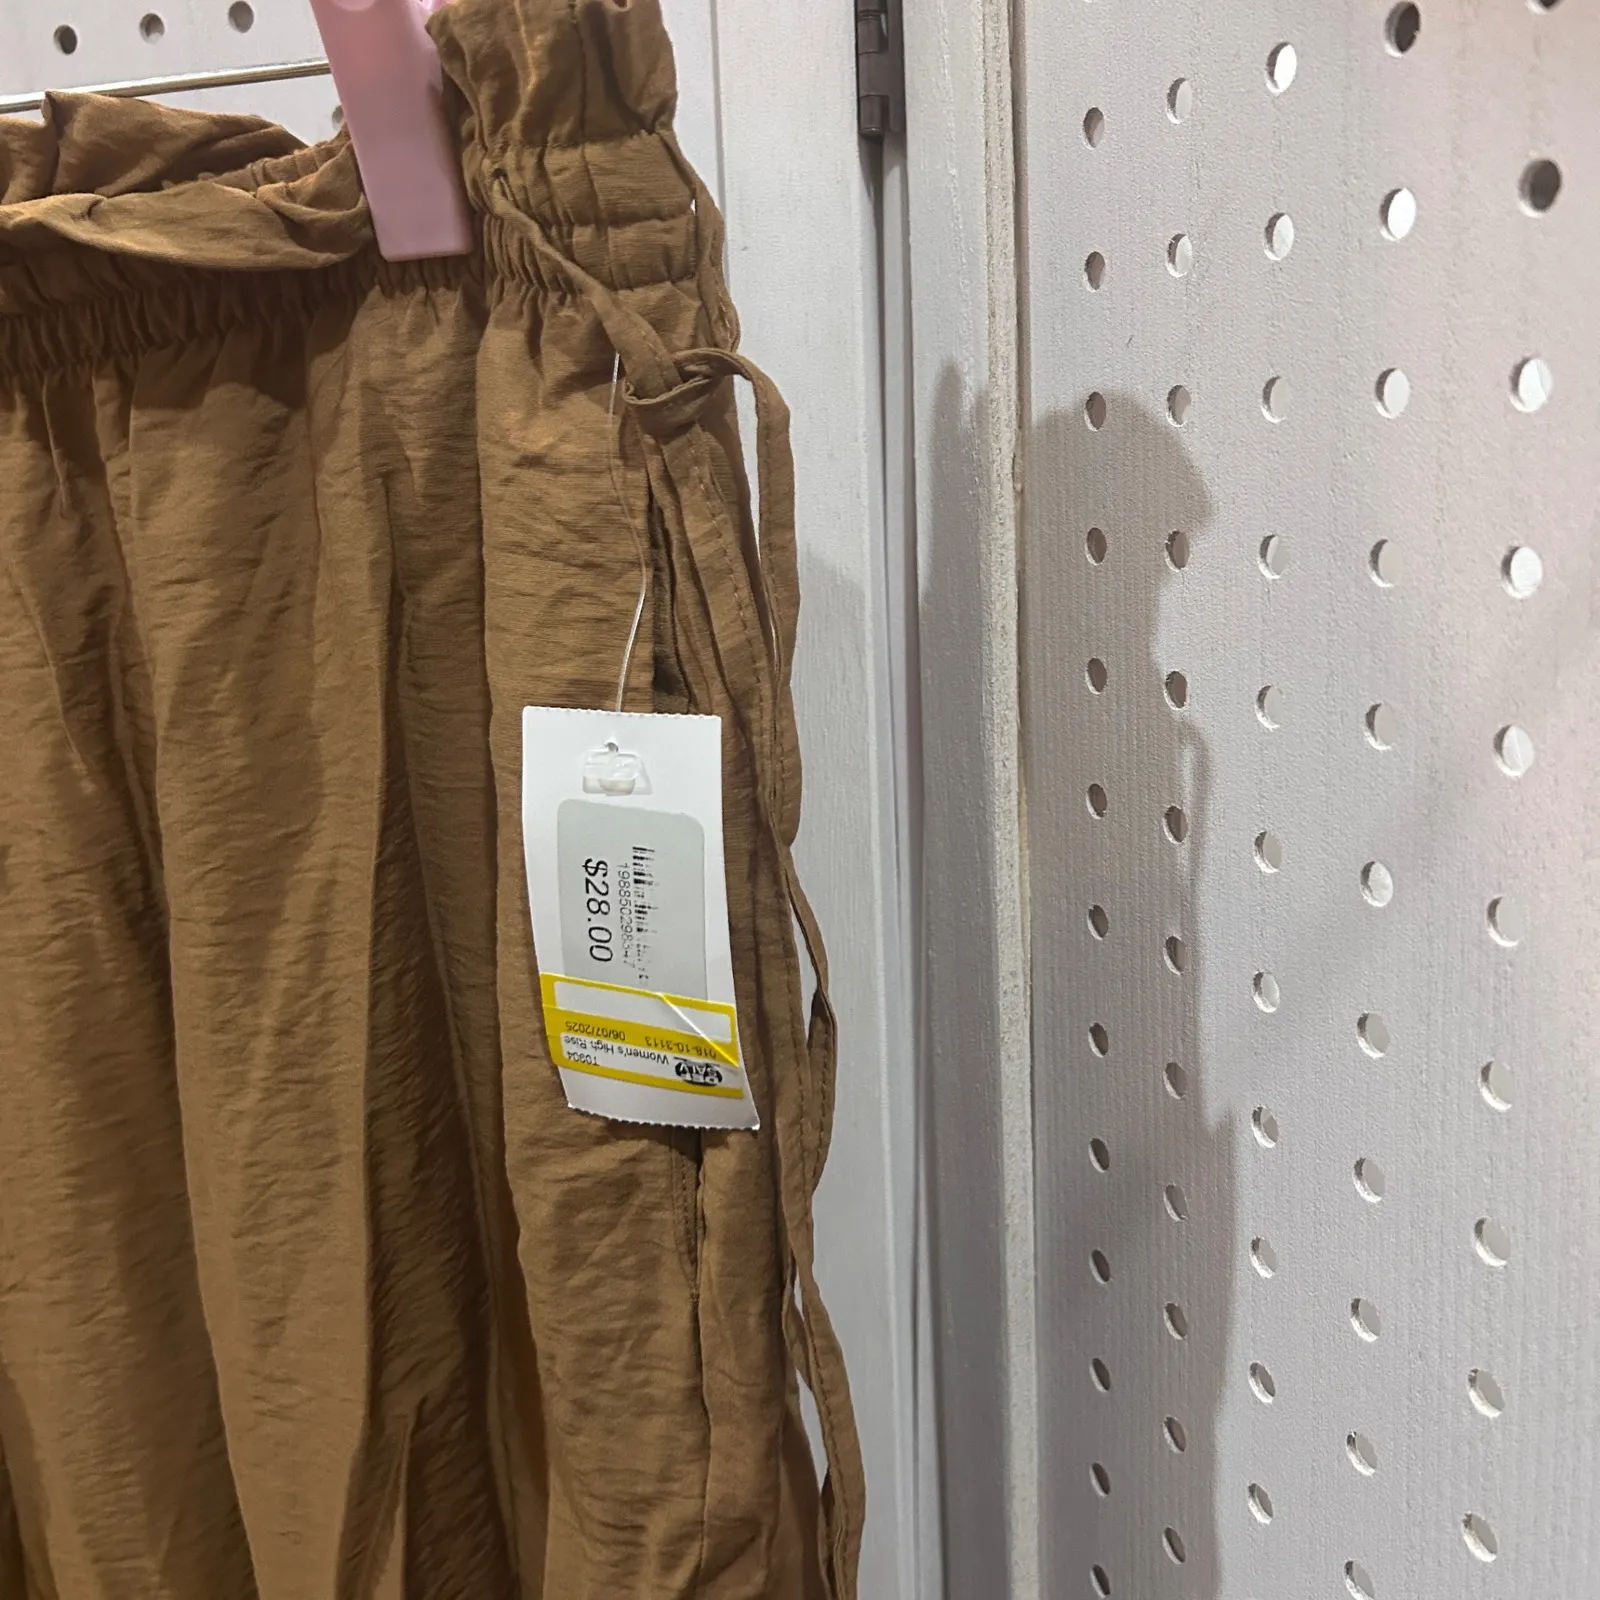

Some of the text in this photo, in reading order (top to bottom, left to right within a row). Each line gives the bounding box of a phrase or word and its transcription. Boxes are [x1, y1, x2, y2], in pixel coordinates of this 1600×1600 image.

[581, 857, 614, 963] $28.00
[565, 1020, 626, 1042] 06/07/2025
[563, 1035, 669, 1066] Women's High Rise
